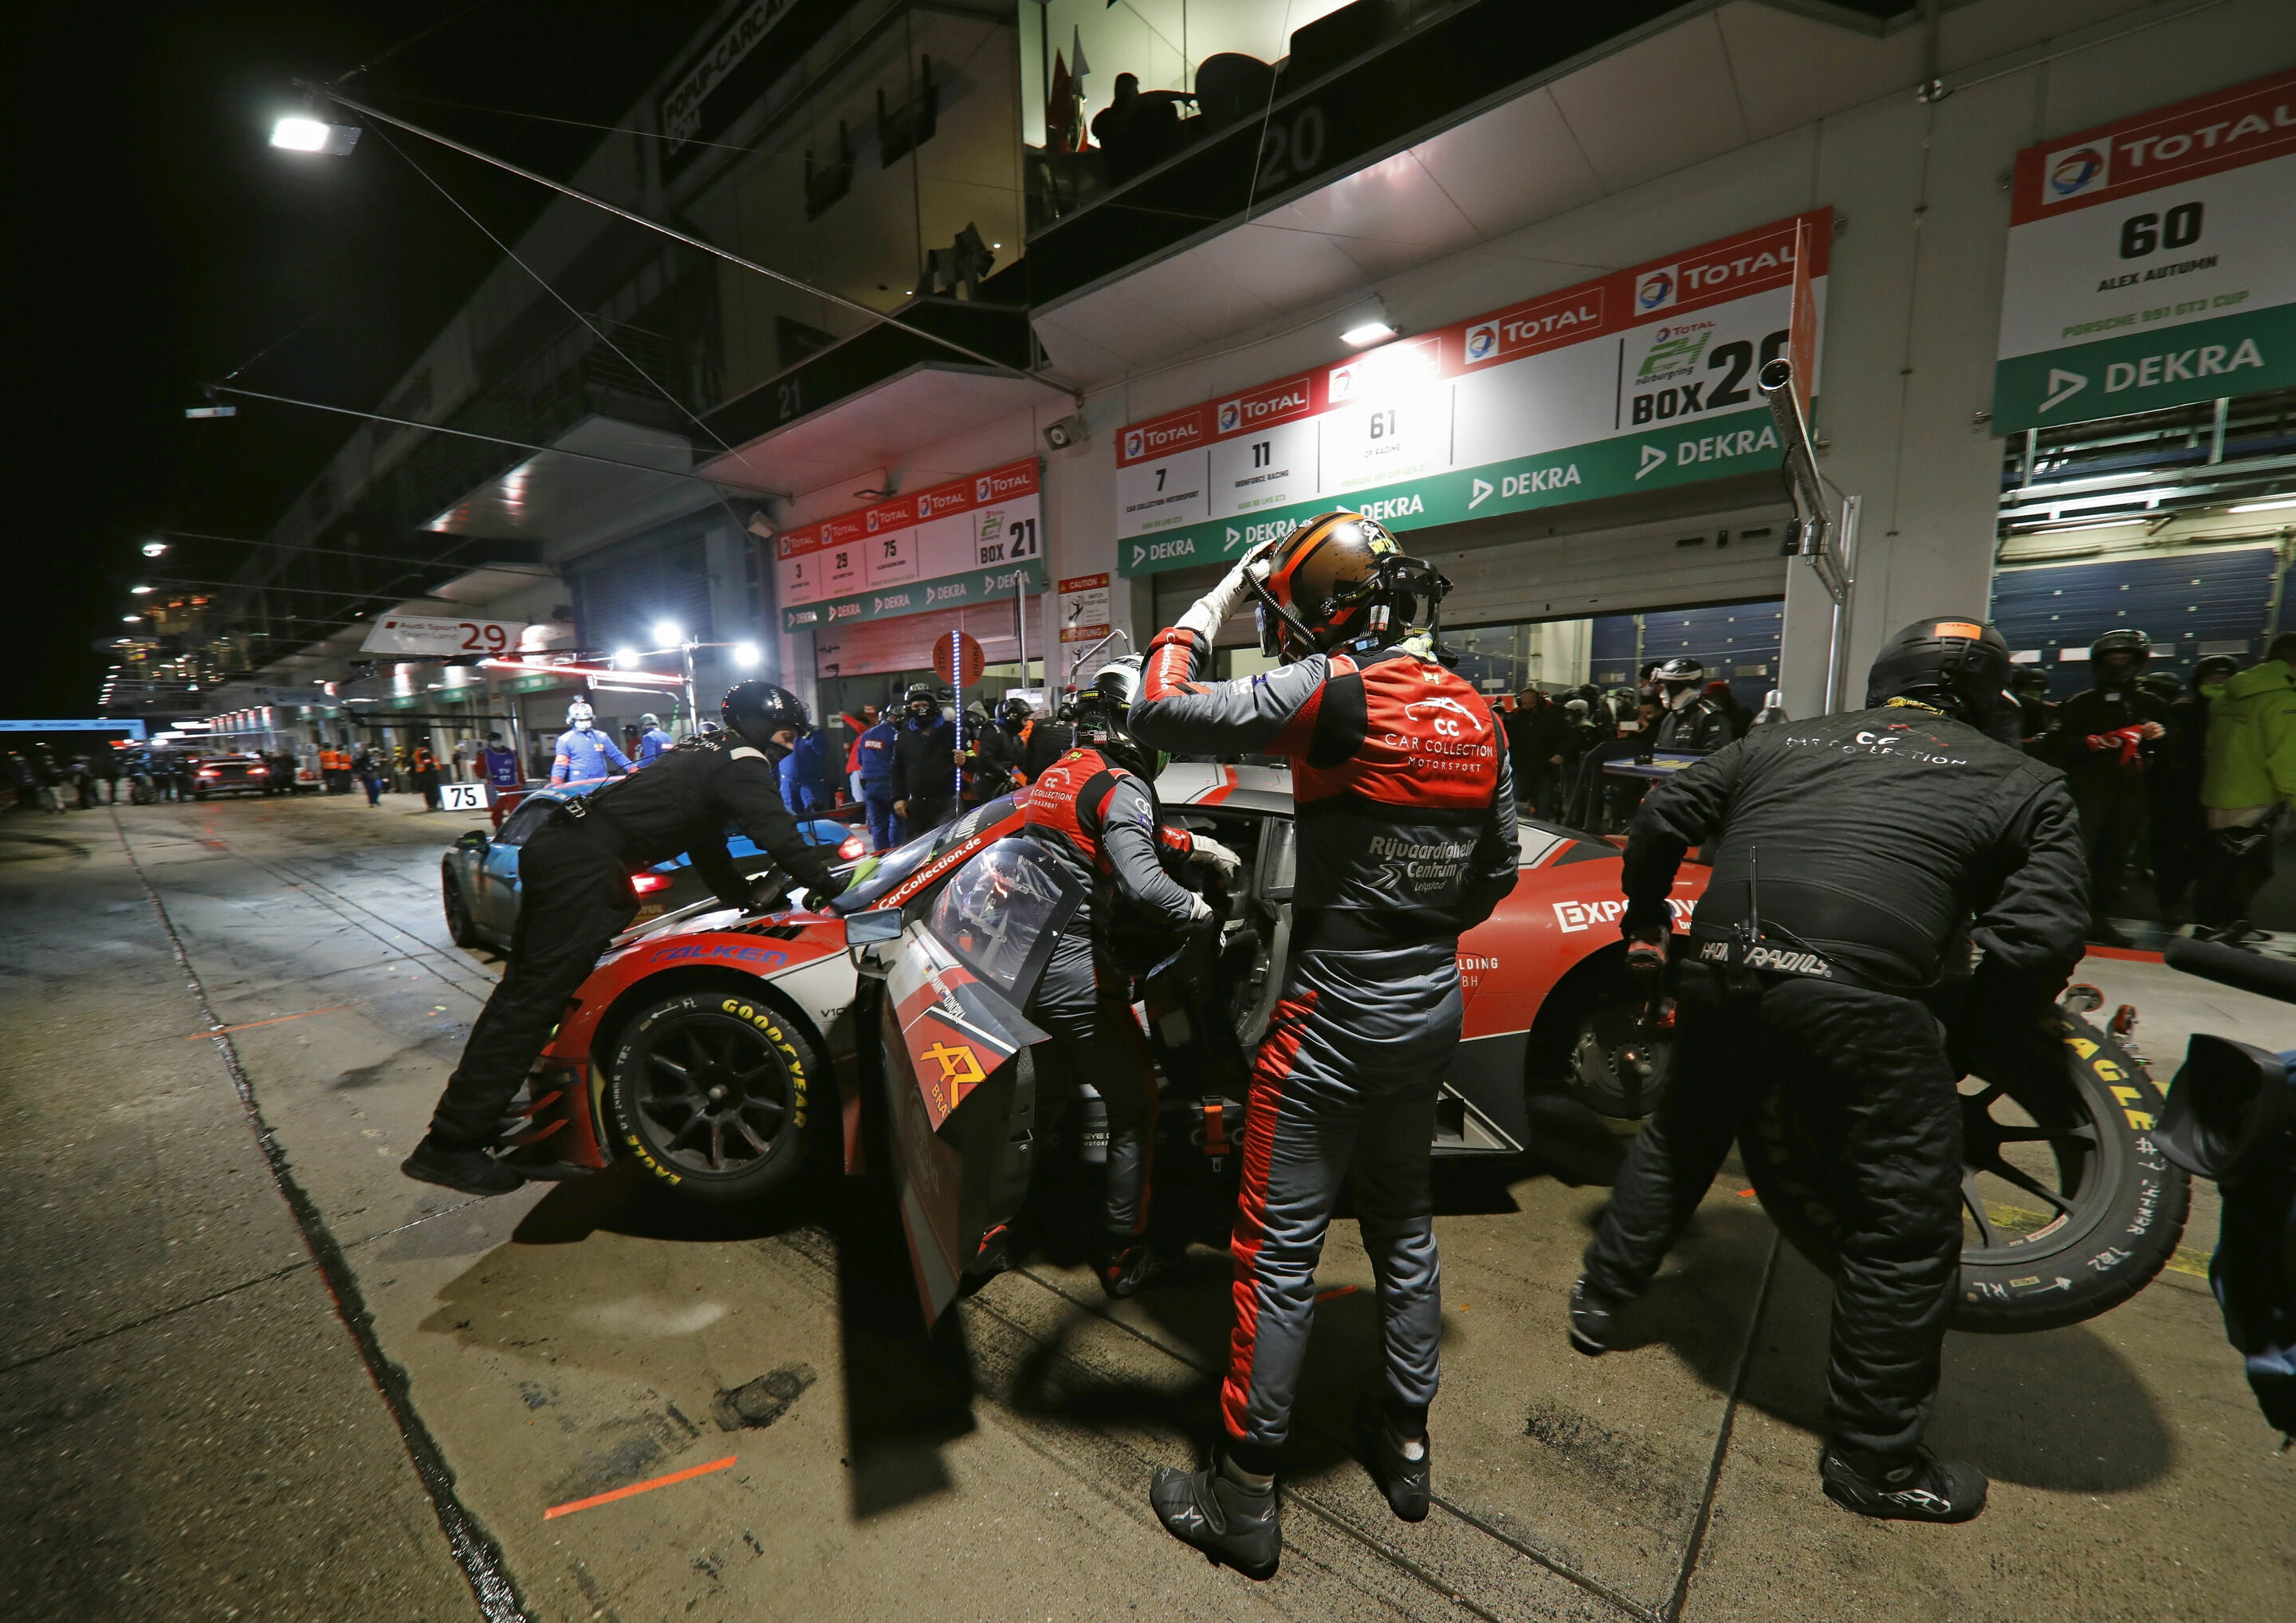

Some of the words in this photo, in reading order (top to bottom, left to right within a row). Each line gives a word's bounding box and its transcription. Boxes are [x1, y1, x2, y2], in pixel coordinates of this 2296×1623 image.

[2118, 104, 2296, 167] TOTAL
[1256, 106, 1324, 191] 20
[2121, 202, 2203, 259] 60
[1684, 246, 1796, 289] TOTAL
[2097, 272, 2139, 293] ALEX
[2143, 255, 2219, 283] AUTUMN
[1504, 306, 1598, 342] TOTAL
[2062, 313, 2135, 338] PORSCHE
[2141, 305, 2170, 322] 991
[2175, 299, 2208, 315] GT3
[2212, 290, 2250, 308] CUP
[1673, 320, 1716, 335] TOTAL
[1635, 366, 1694, 385] nürburgring
[2105, 338, 2265, 393] DEKRA
[778, 378, 800, 419] 21
[1244, 392, 1305, 418] TOTAL
[1633, 381, 1704, 426] BOX
[1147, 424, 1198, 446] TOTAL
[1370, 409, 1395, 439] 61
[1252, 441, 1270, 468] 11
[1678, 426, 1778, 466] DEKRA
[993, 475, 1030, 491] TOTAL
[1156, 468, 1166, 492] 7
[1502, 464, 1582, 498] DEKRA
[932, 493, 965, 509] TOTAL
[1360, 494, 1424, 520] DEKRA
[879, 509, 908, 524] TOTAL
[790, 536, 814, 548] TOTAL
[832, 524, 859, 536] TOTAL
[981, 544, 1005, 564] BOX
[1010, 518, 1036, 558] 21
[1245, 518, 1298, 544] DEKRA
[836, 552, 848, 569] 29
[883, 540, 896, 558] 75
[1150, 537, 1195, 560] DEKRA
[796, 564, 802, 579] 3
[1070, 578, 1097, 588] CAUTION
[885, 595, 910, 609] DEKRA
[938, 584, 966, 600] DEKRA
[796, 611, 817, 623] DEKRA
[838, 603, 861, 617] DEKRA
[459, 623, 506, 650] 29
[1434, 719, 1460, 737] CC
[1385, 733, 1420, 750] CAR
[1425, 739, 1493, 757] COLLECTION
[1408, 756, 1481, 772] MOTORSPORT
[451, 788, 476, 807] 75
[1035, 788, 1072, 801] COLLECTION
[878, 837, 981, 910] CarCollection.de
[1414, 880, 1447, 892] Lelystad
[651, 945, 788, 965] FALKEN
[1744, 947, 1828, 975] RADIOS
[682, 998, 698, 1008] FL
[942, 993, 965, 1024] KONOPKA
[721, 999, 808, 1128] GOODYEAR
[2059, 1019, 2156, 1132] AGLE
[627, 1134, 682, 1186] EAGLE
